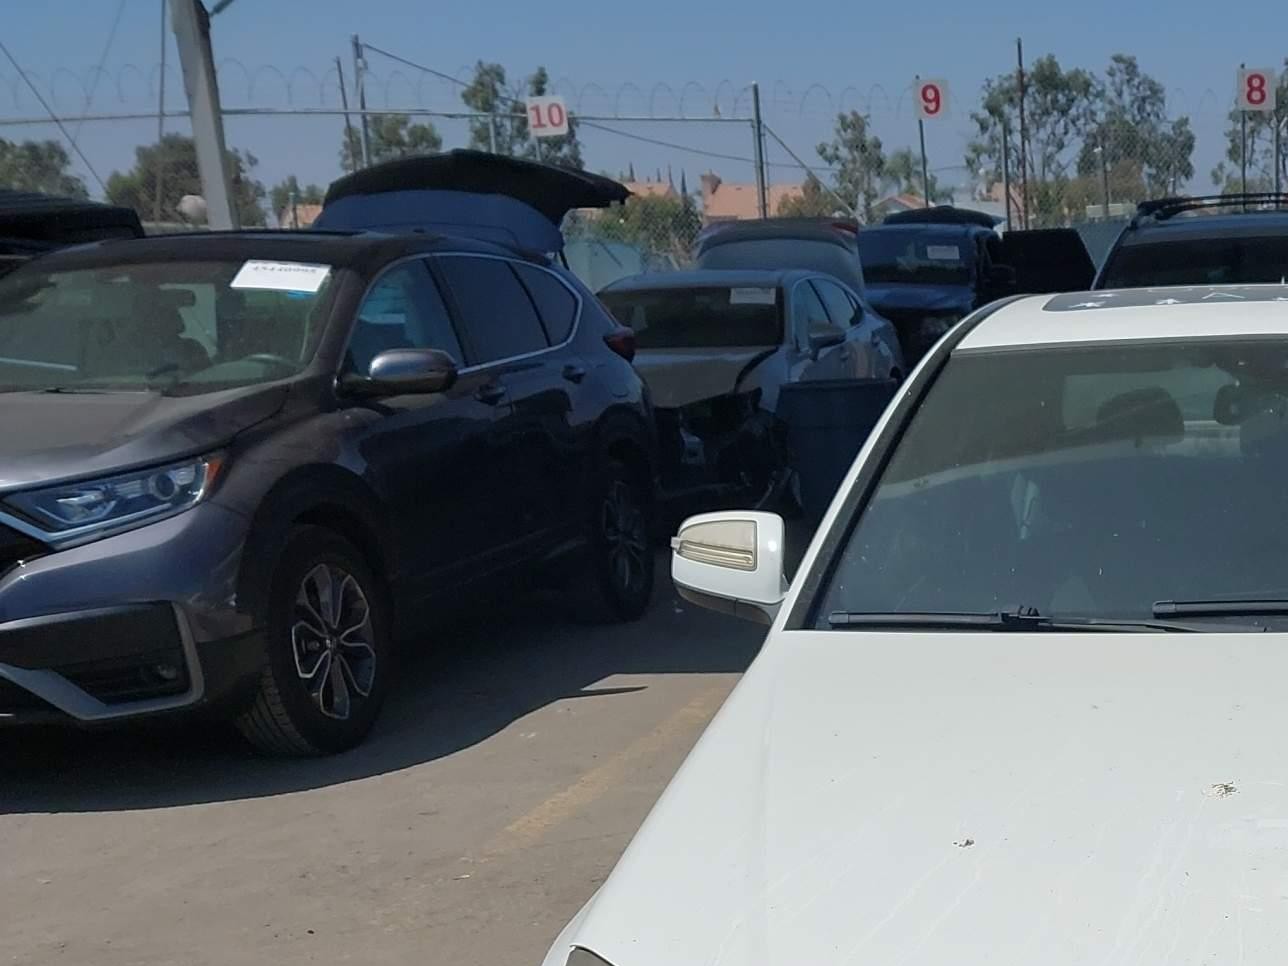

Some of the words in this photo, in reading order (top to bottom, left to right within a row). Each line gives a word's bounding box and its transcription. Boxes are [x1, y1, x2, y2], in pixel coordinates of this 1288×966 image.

[921, 84, 940, 115] 9
[1247, 73, 1266, 105] 8
[530, 103, 564, 128] 10
